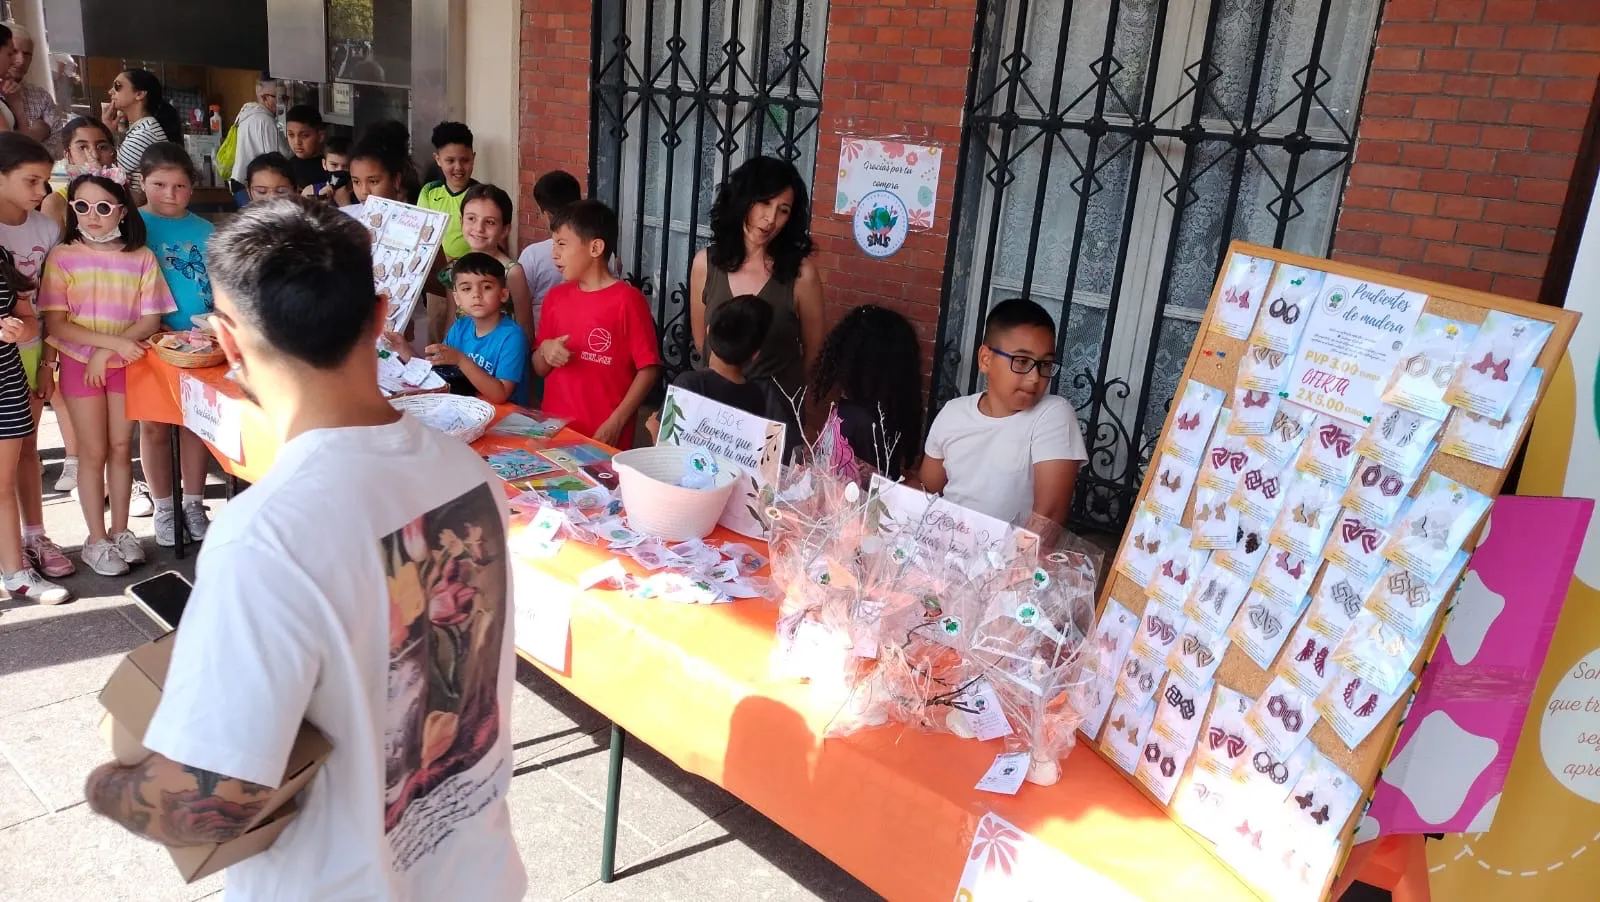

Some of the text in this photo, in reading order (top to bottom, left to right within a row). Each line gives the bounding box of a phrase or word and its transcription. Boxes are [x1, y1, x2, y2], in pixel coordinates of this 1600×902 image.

[863, 160, 912, 174] Gracias por tu
[1351, 282, 1410, 313] Pendientes
[1342, 305, 1405, 334] de madera
[1304, 350, 1329, 365] PVP
[1296, 387, 1306, 399] 2
[693, 417, 753, 449] Llaveros que
[724, 445, 734, 458] tu
[735, 453, 758, 468] vida
[1548, 699, 1582, 717] que
